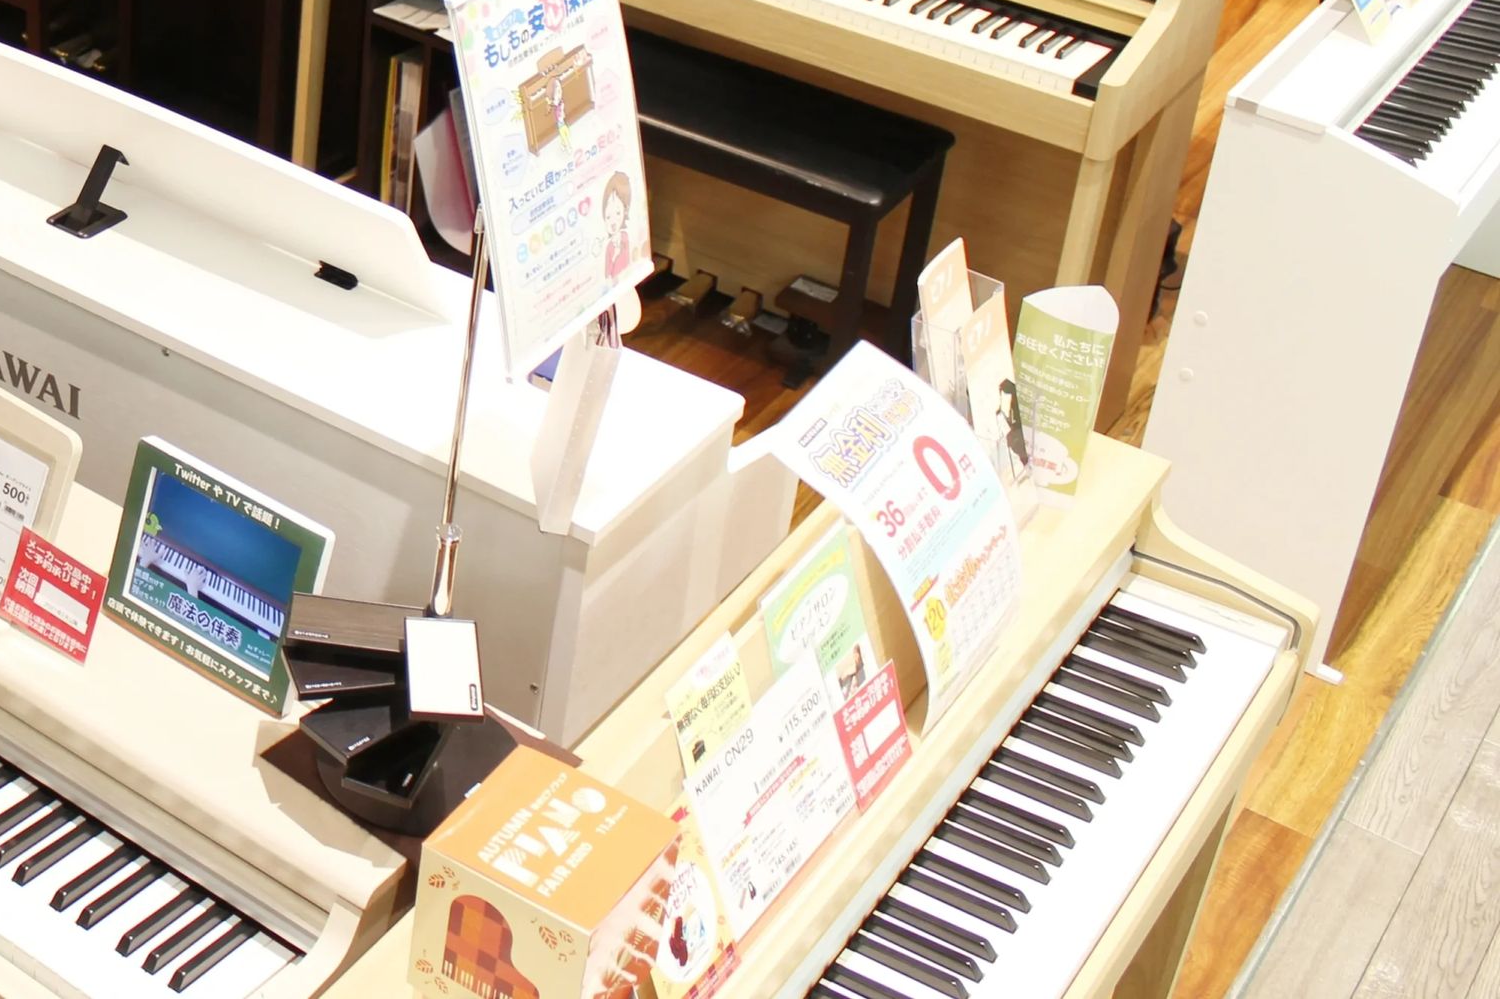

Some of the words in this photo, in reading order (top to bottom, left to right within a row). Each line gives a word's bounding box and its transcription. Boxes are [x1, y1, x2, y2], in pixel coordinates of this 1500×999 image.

[1053, 333, 1105, 357] 私たちに
[174, 463, 211, 492] Twitter
[225, 490, 241, 508] TV
[243, 500, 280, 530] で話題!
[876, 499, 905, 538] 36
[20, 567, 39, 588] 次回
[24, 548, 97, 600] ご予約承ります!
[26, 539, 92, 586] メーカー欠品中
[14, 580, 36, 599] 納期
[167, 591, 242, 651] 魔法の伴奏
[924, 601, 947, 636] 120
[695, 766, 721, 796] KAWAI
[724, 728, 755, 768] CN29
[477, 807, 533, 863] AUTUMN
[492, 787, 606, 888] PIANO
[536, 865, 572, 898] FAIR
[566, 841, 593, 869] 2020
